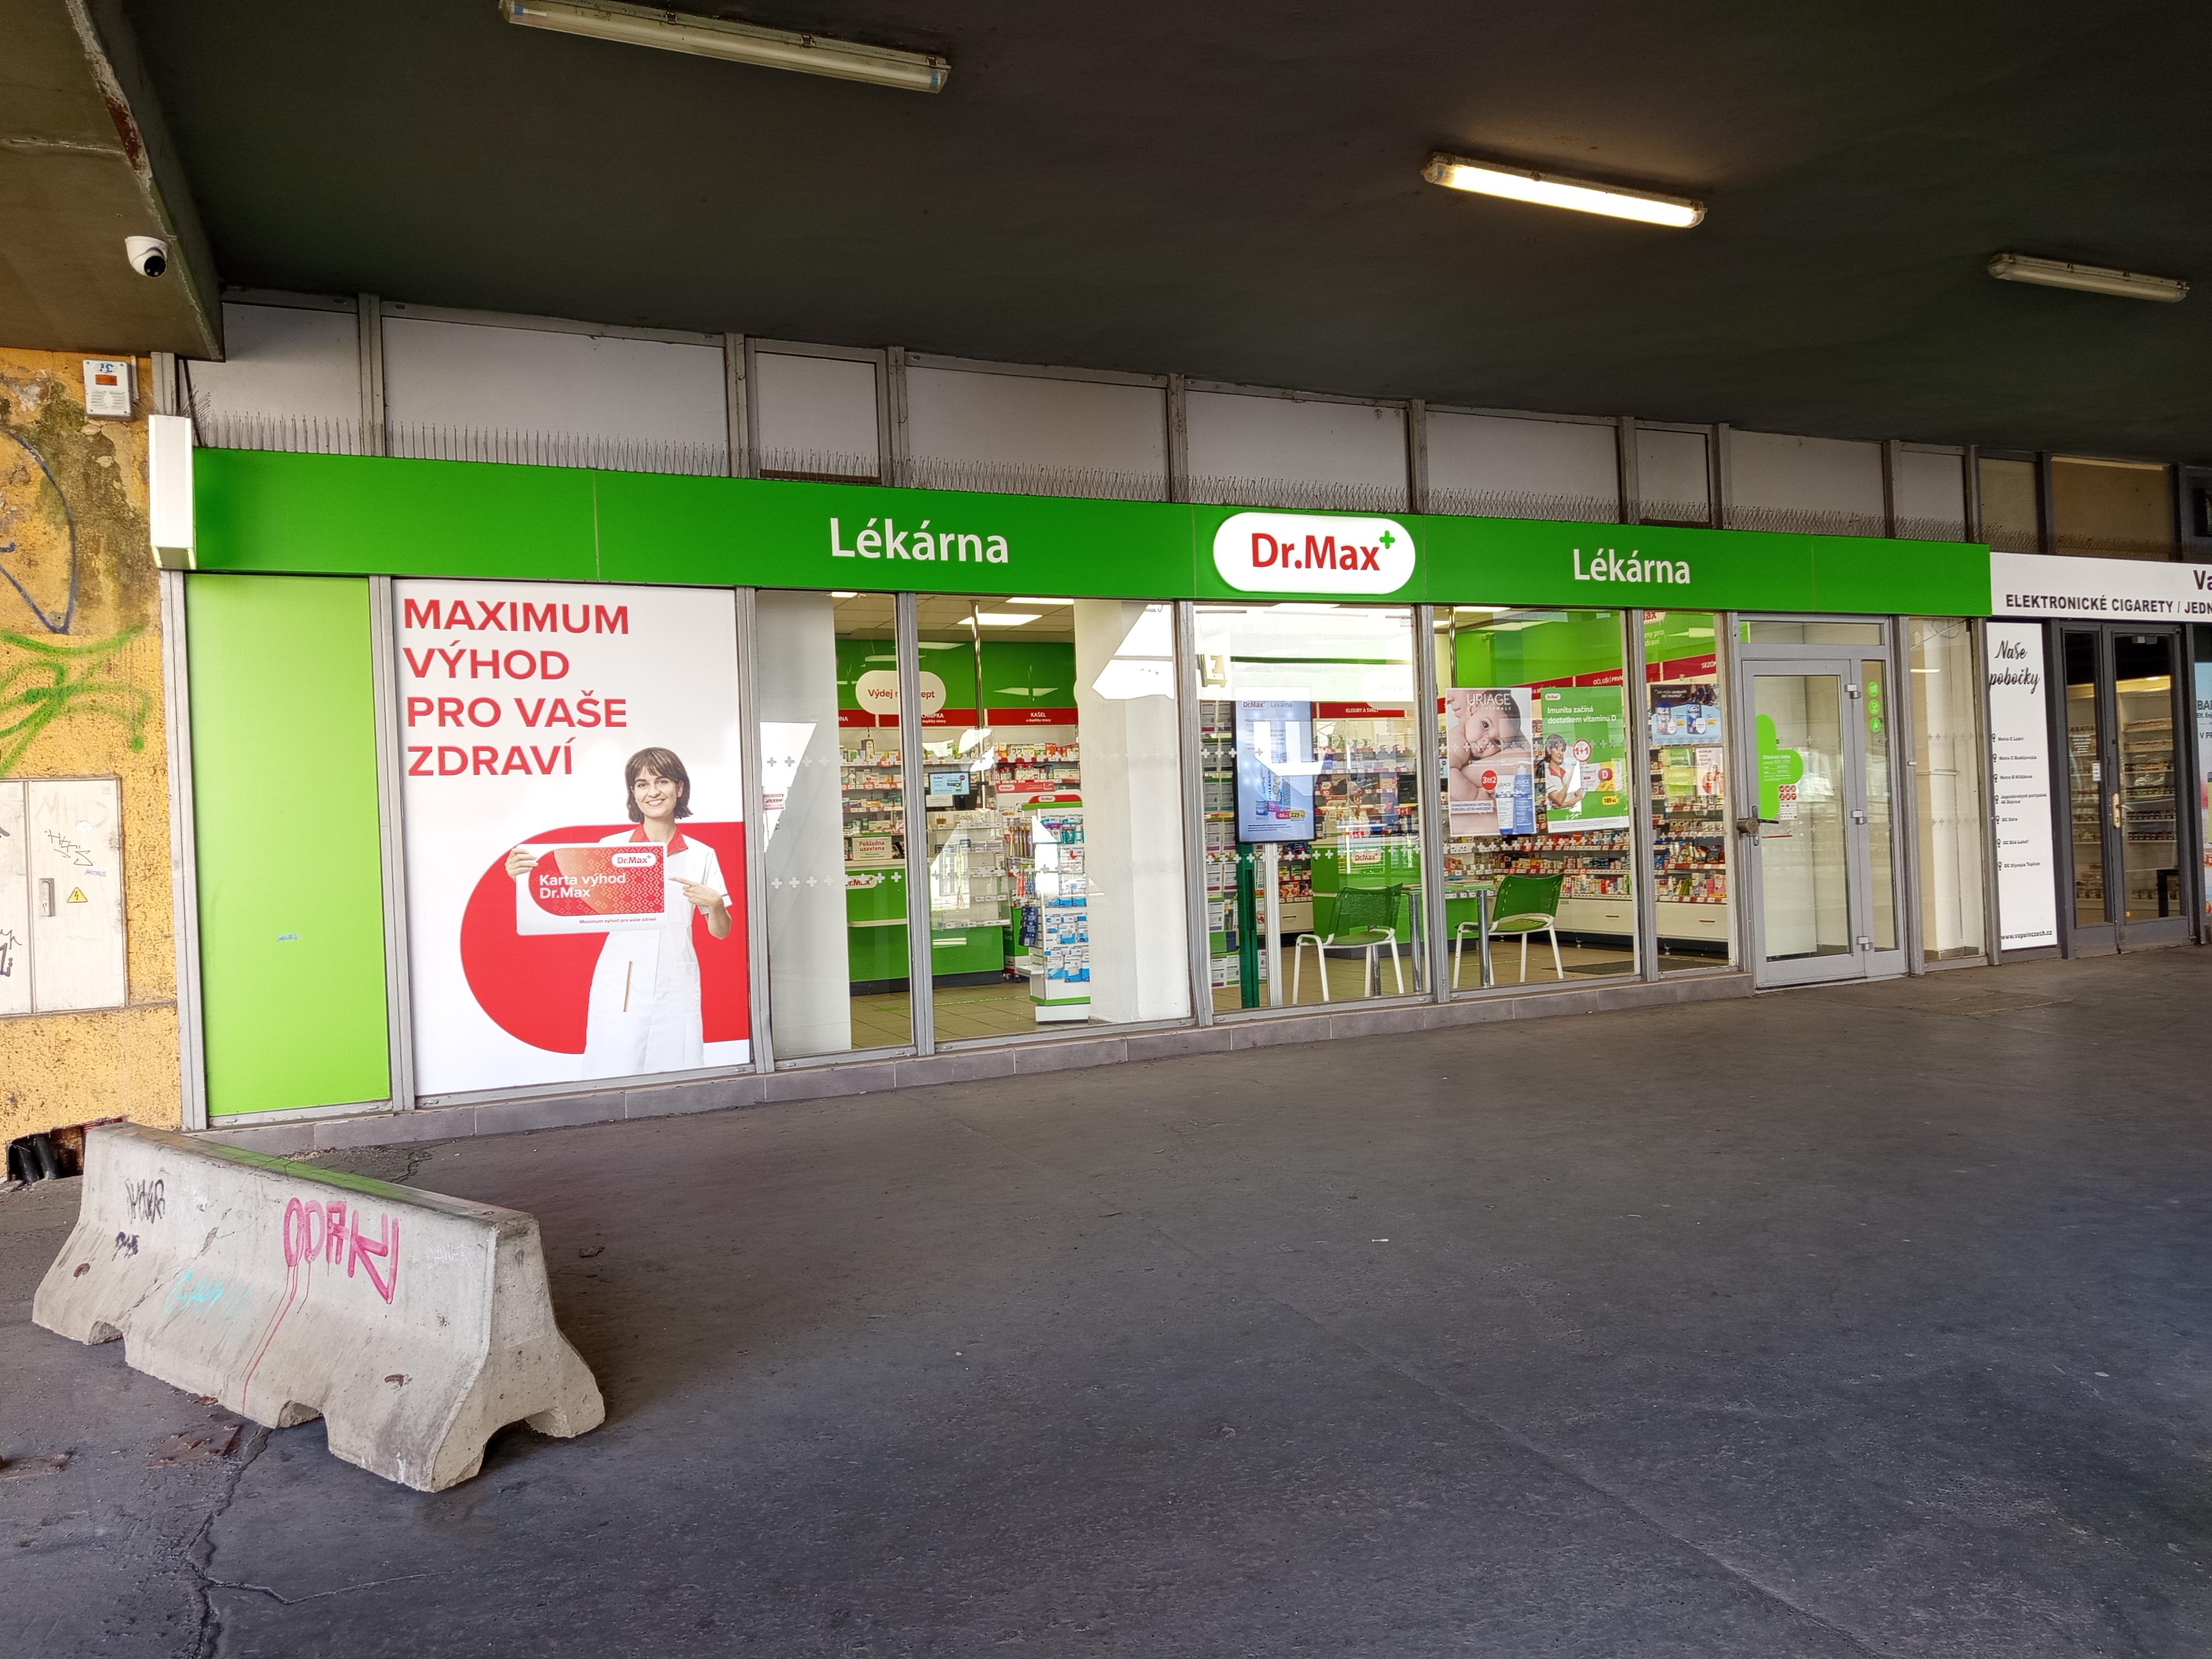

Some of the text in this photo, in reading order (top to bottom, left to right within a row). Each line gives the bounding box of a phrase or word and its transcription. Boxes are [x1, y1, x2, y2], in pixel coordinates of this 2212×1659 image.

[830, 517, 1009, 563] Lékárna
[1251, 532, 1381, 571] Dr.Max
[1573, 548, 1691, 584] Lékárna
[2006, 594, 2107, 611] ELEKTRONICKÉ
[2111, 598, 2173, 613] CIGARETY
[404, 598, 629, 635] MAXIMUM
[1643, 612, 1657, 620] ax
[402, 640, 570, 680] VÝHOD
[1994, 640, 2028, 660] Naše
[1990, 667, 2041, 695] pobočky
[868, 688, 893, 699] Výdej
[1467, 693, 1511, 706] URIAGE
[407, 690, 627, 728] PRO VAŠE
[1548, 716, 1582, 724] dostatkem
[407, 737, 576, 776] ZDRAVÍ
[539, 872, 626, 887] Karta výhod
[540, 887, 591, 899] Dr.Max
